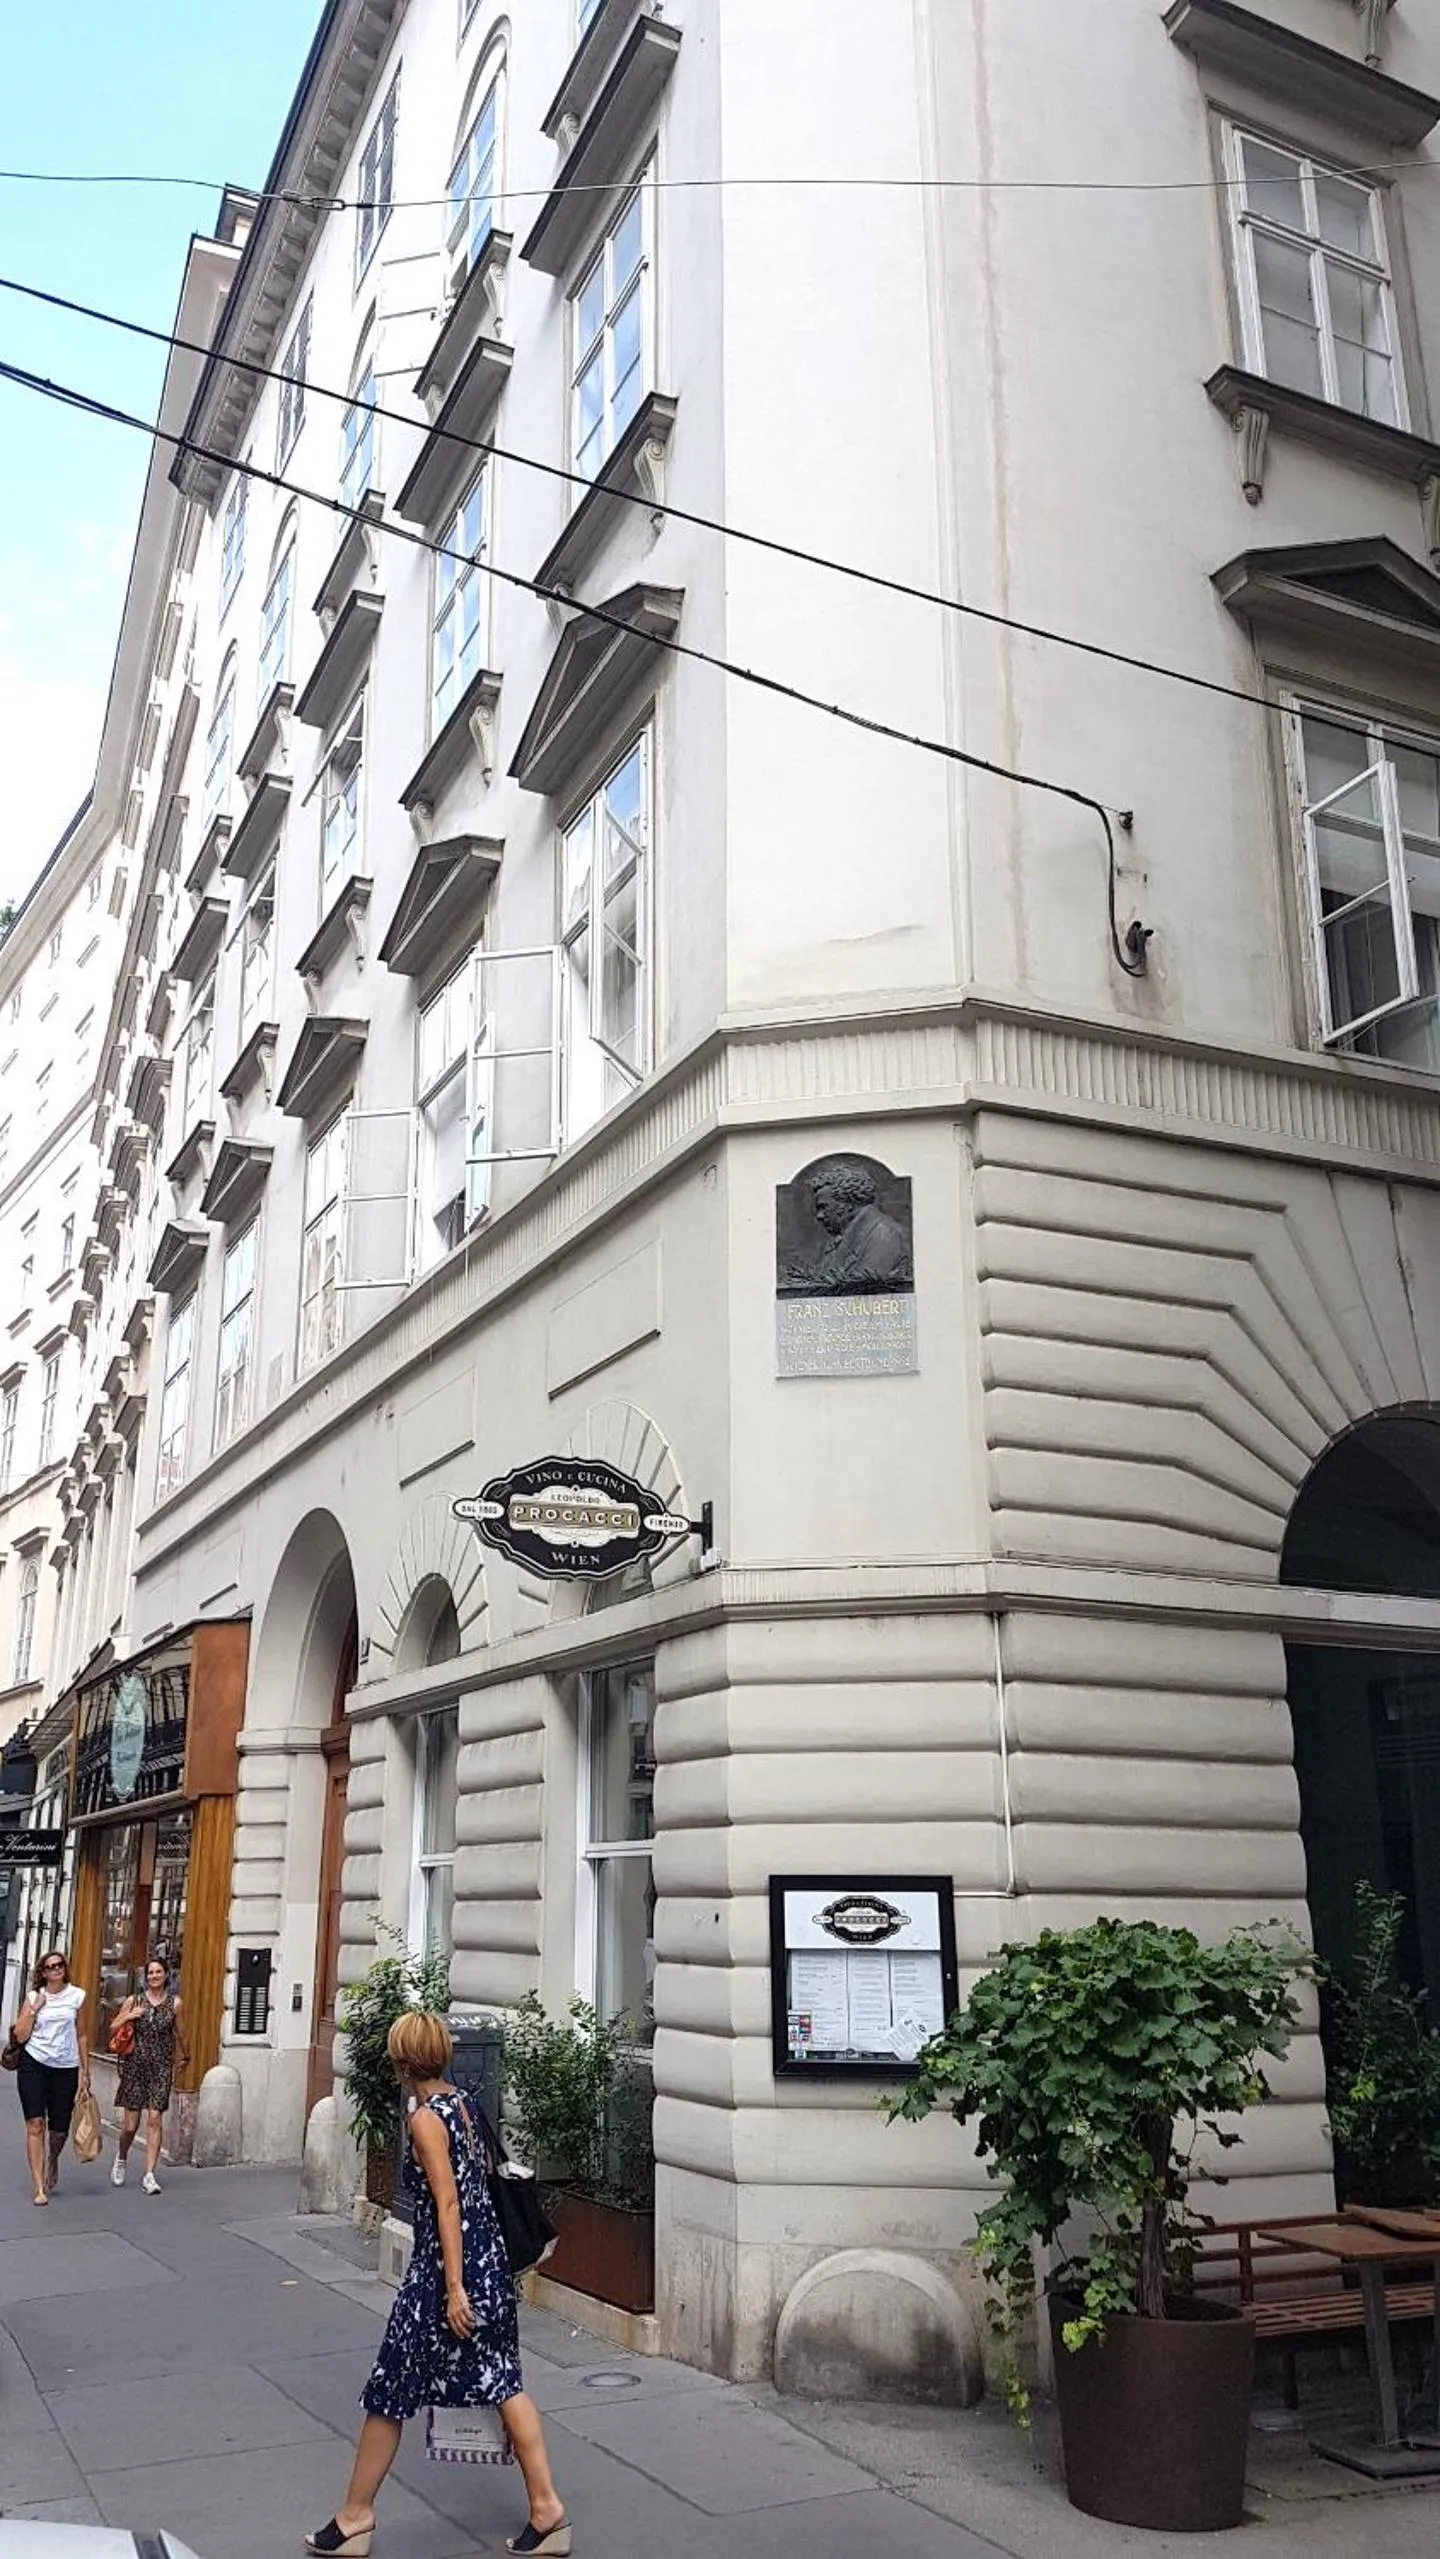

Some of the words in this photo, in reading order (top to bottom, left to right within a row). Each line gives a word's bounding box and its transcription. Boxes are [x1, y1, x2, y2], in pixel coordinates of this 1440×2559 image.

[788, 1303, 831, 1320] FRANZ
[836, 1299, 908, 1316] SCHUBERT
[526, 1472, 562, 1485] VINO
[578, 1471, 626, 1494] CUCINA
[551, 1494, 601, 1503] LEOPOLDO
[514, 1506, 635, 1527] PROCACCI
[551, 1551, 601, 1565] WIEN
